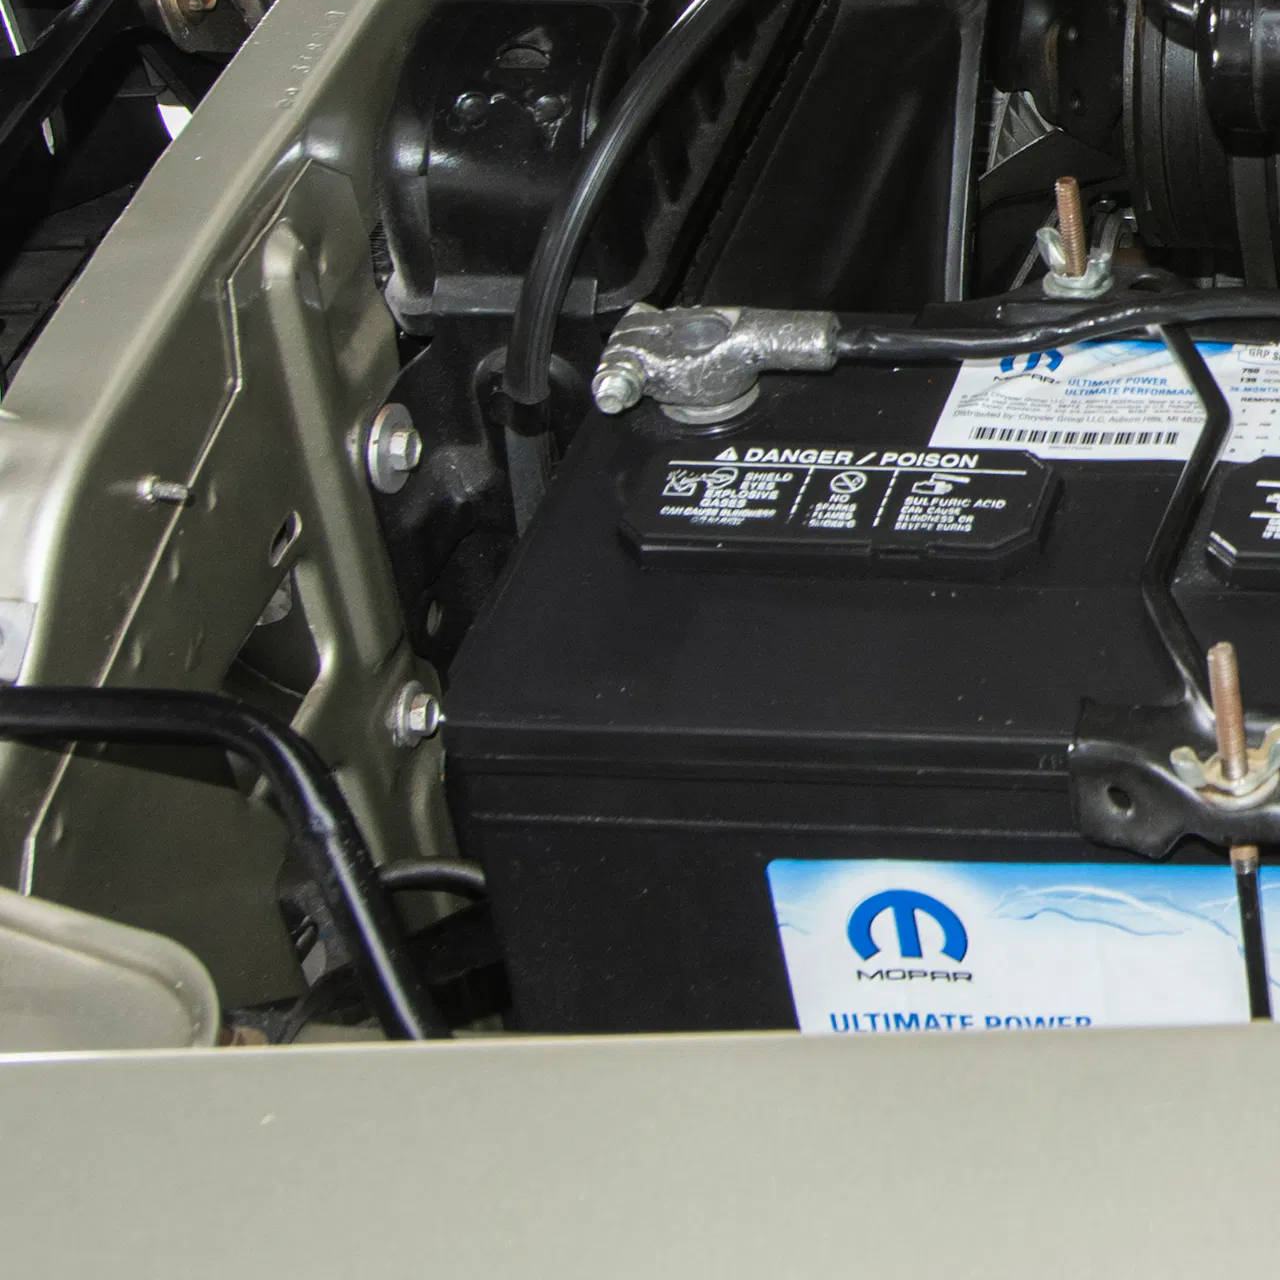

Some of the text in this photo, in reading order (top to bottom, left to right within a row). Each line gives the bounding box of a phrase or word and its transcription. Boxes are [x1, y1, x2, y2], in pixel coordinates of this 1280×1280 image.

[1249, 348, 1270, 359] GRP
[1068, 376, 1168, 387] ULTIMATE POWER
[1064, 387, 1119, 397] ULTIMATE
[1018, 413, 1055, 421] Chrysler
[1056, 415, 1085, 424] Group
[744, 448, 854, 464] DANGER
[879, 453, 979, 468] POISON
[744, 473, 794, 482] SHIELD
[740, 482, 777, 490] EYES
[704, 490, 779, 500] EXPLOSIVE
[829, 494, 851, 503] NO
[700, 499, 749, 508] GASES
[815, 503, 857, 512] SPARKS
[904, 496, 1006, 509] SULFURIC ACID
[811, 511, 854, 520] FLAMES
[900, 506, 962, 516] CAN CAUSE
[898, 515, 955, 524] BLINDNESS
[894, 523, 973, 532] SEVERE BURNS
[857, 968, 973, 983] MOPAR
